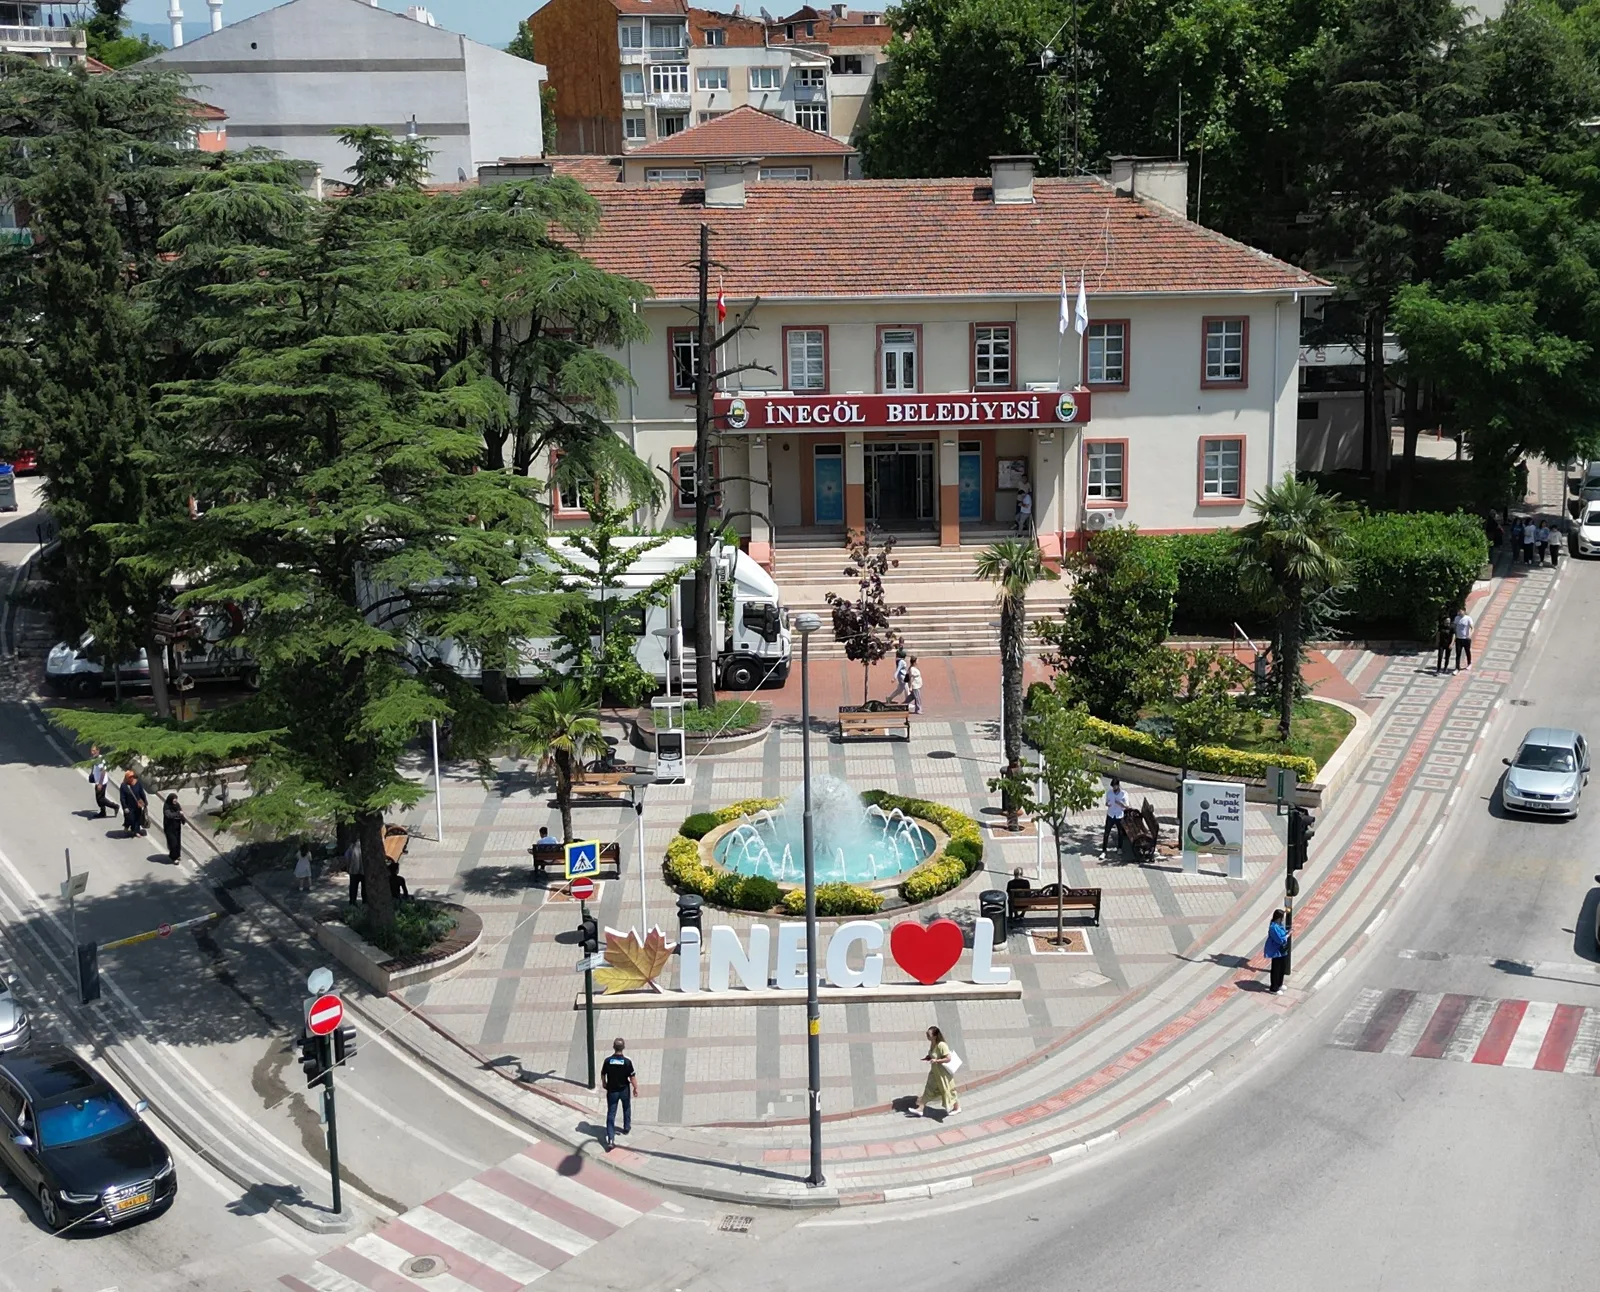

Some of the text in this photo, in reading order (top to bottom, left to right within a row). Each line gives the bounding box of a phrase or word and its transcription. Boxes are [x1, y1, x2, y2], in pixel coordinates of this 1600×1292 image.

[765, 396, 1040, 423] İNEGÖL BELEDİYESİ
[1213, 798, 1240, 806] kapak
